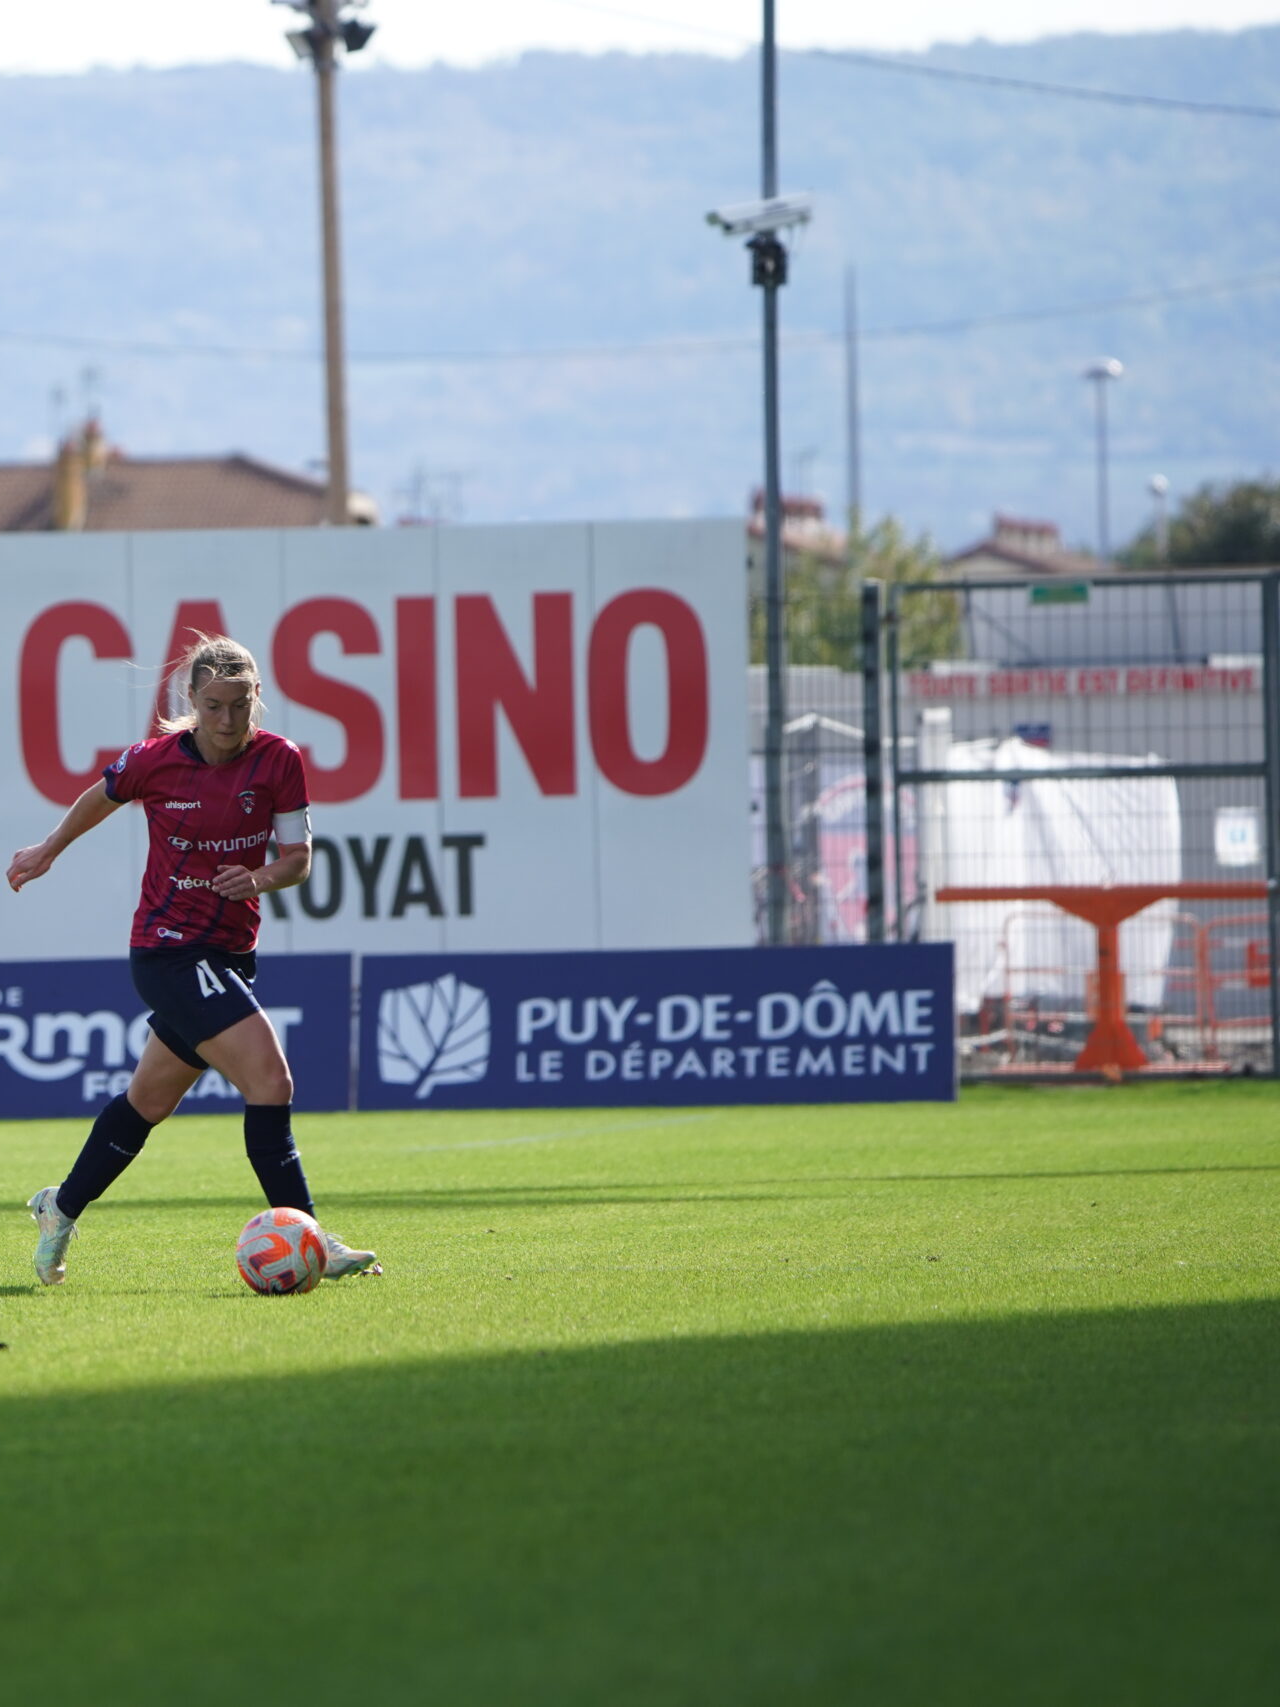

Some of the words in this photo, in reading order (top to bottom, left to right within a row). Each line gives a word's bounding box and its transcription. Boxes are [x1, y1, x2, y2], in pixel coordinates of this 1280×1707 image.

[165, 801, 202, 811] uhlsport
[198, 828, 269, 853] HYUNDAI
[517, 979, 936, 1044] PUY-DE-DÔME
[516, 1049, 564, 1082] LE
[584, 1041, 936, 1081] DÉPARTEMENT
